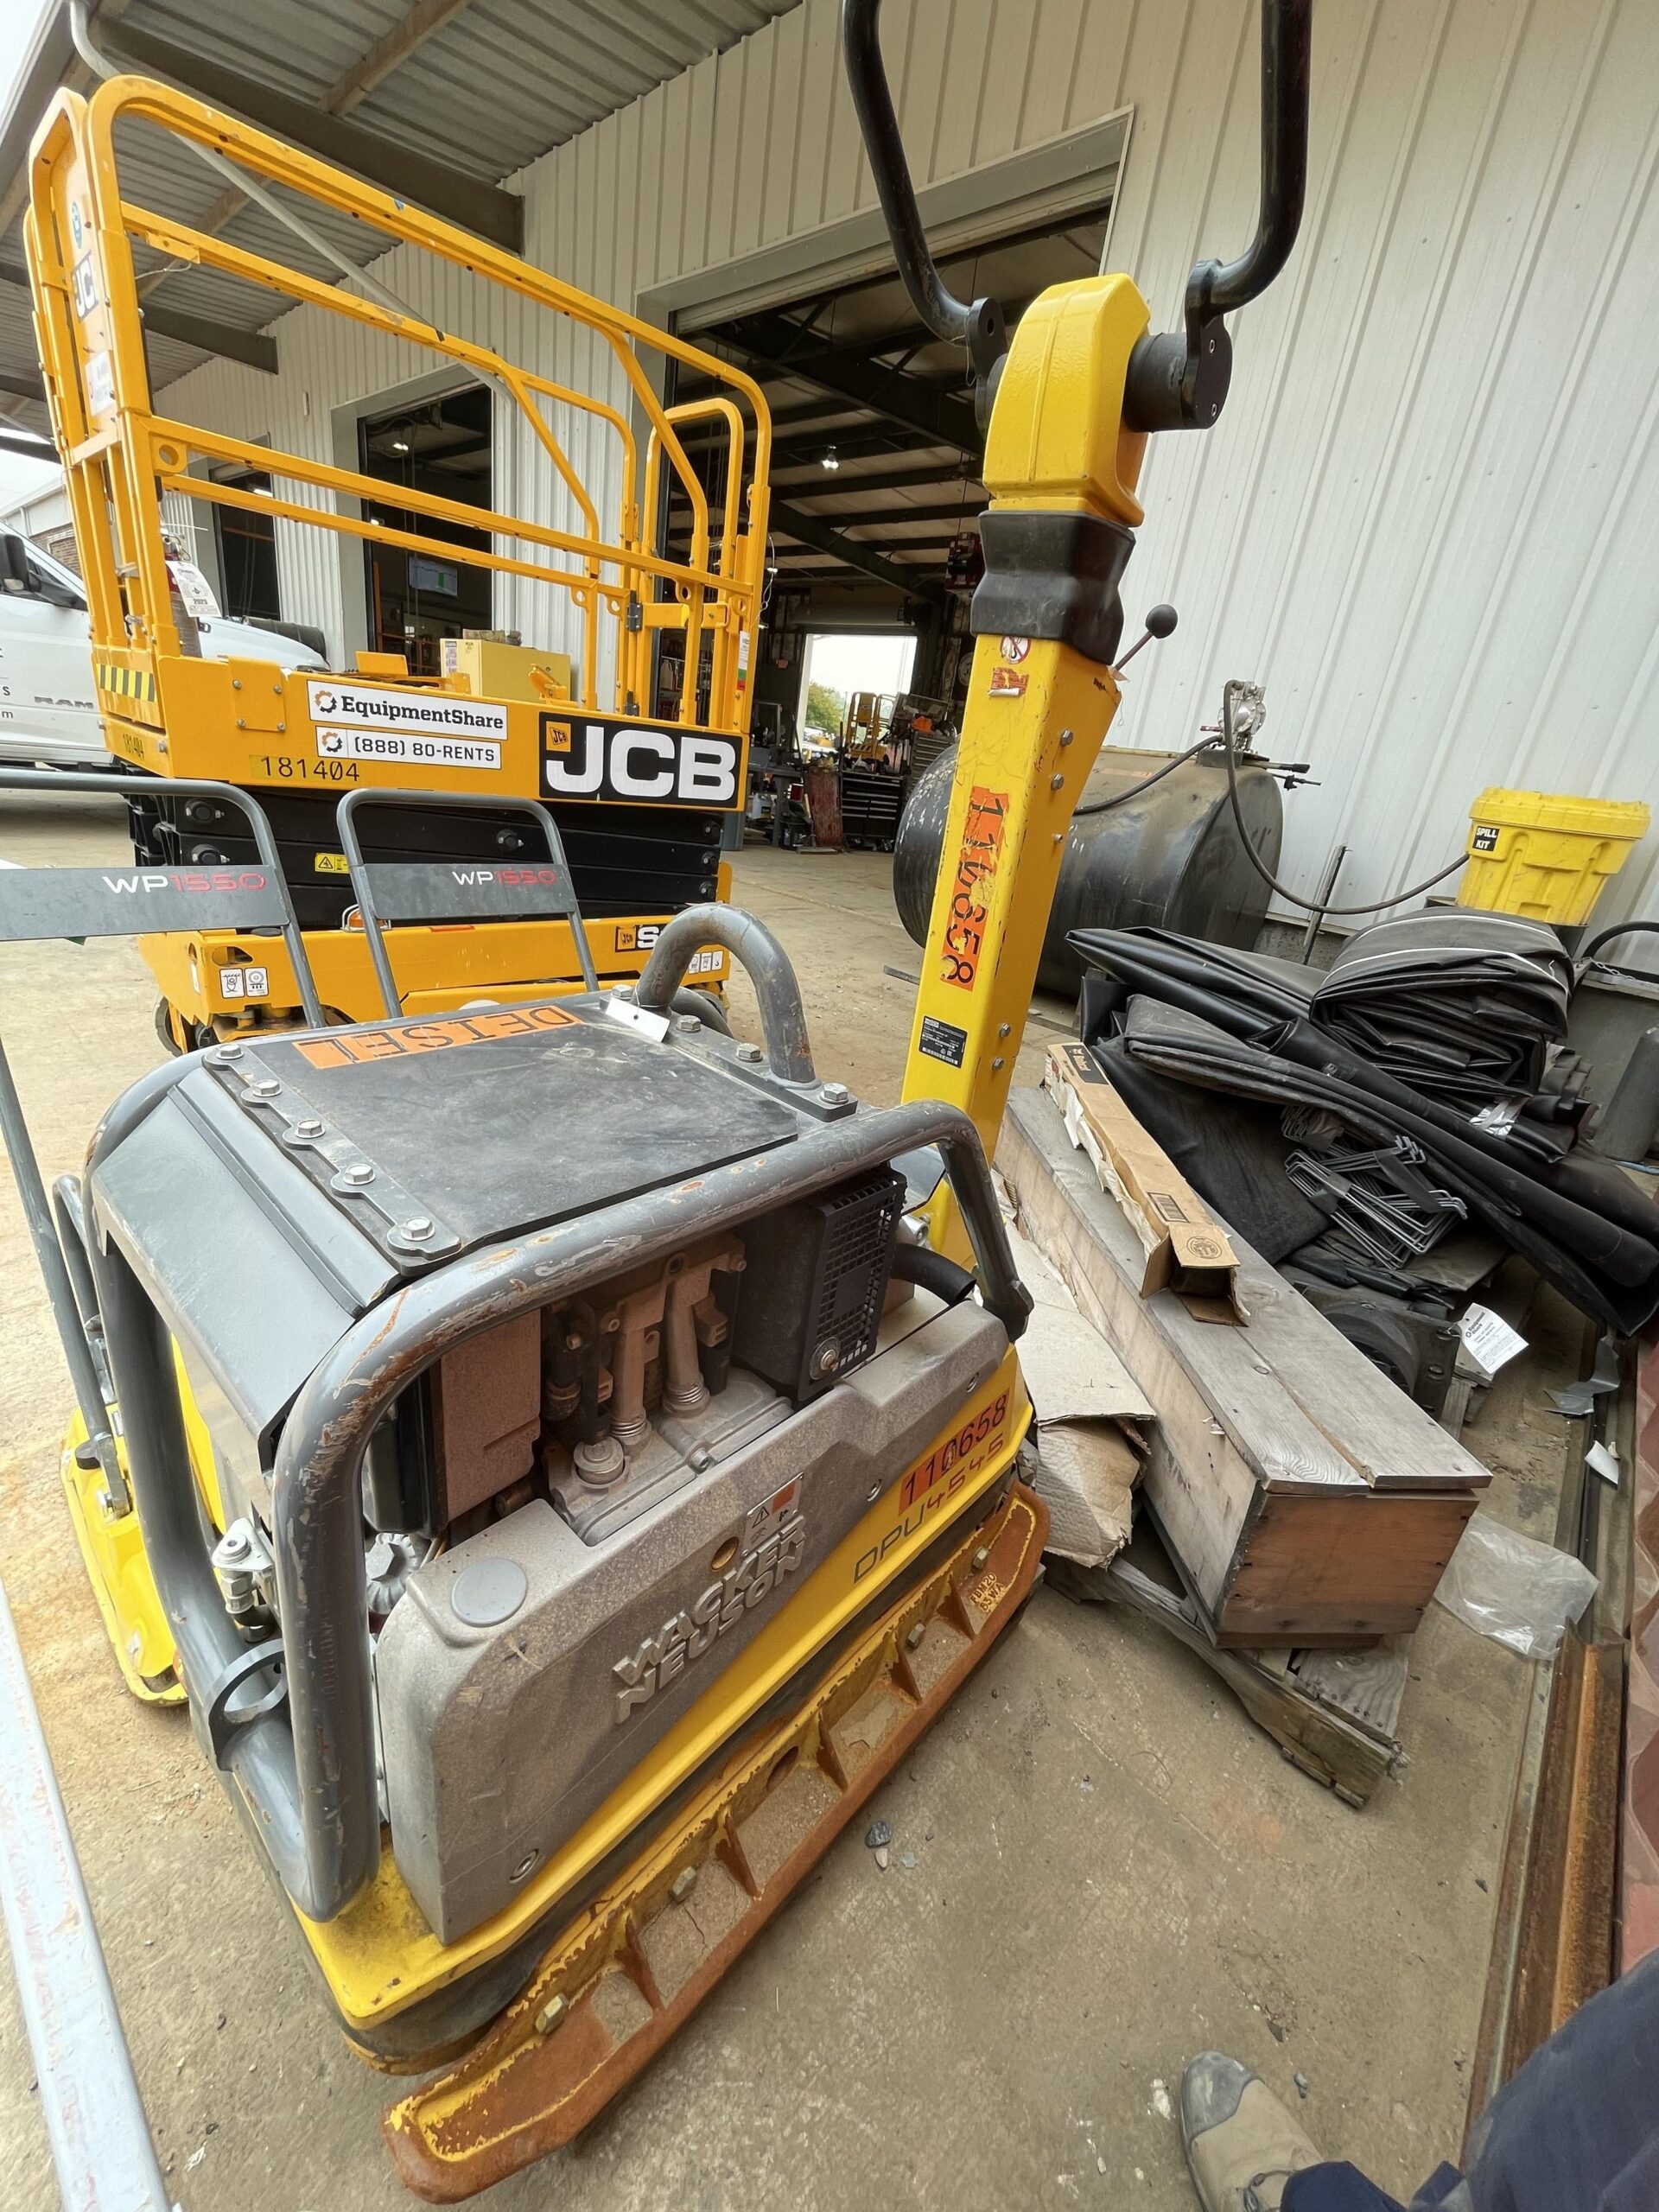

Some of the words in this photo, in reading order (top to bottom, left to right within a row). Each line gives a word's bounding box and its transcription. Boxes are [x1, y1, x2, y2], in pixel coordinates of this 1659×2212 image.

[34, 696, 94, 709] RAM
[341, 696, 504, 729] EquipmentShare
[550, 728, 568, 745] JCB
[413, 743, 494, 761] 80-RENTS
[546, 725, 736, 801] JCB
[261, 756, 359, 782] 181404
[1475, 839, 1491, 849] KIT
[1476, 827, 1497, 839] SPILL
[102, 871, 267, 893] WP1550
[452, 869, 557, 886] WP1550
[298, 1007, 576, 1065] DEISEL
[905, 1394, 1007, 1506] 110658
[612, 1515, 806, 1685] WACKER
[615, 1537, 805, 1725] NEUSON
